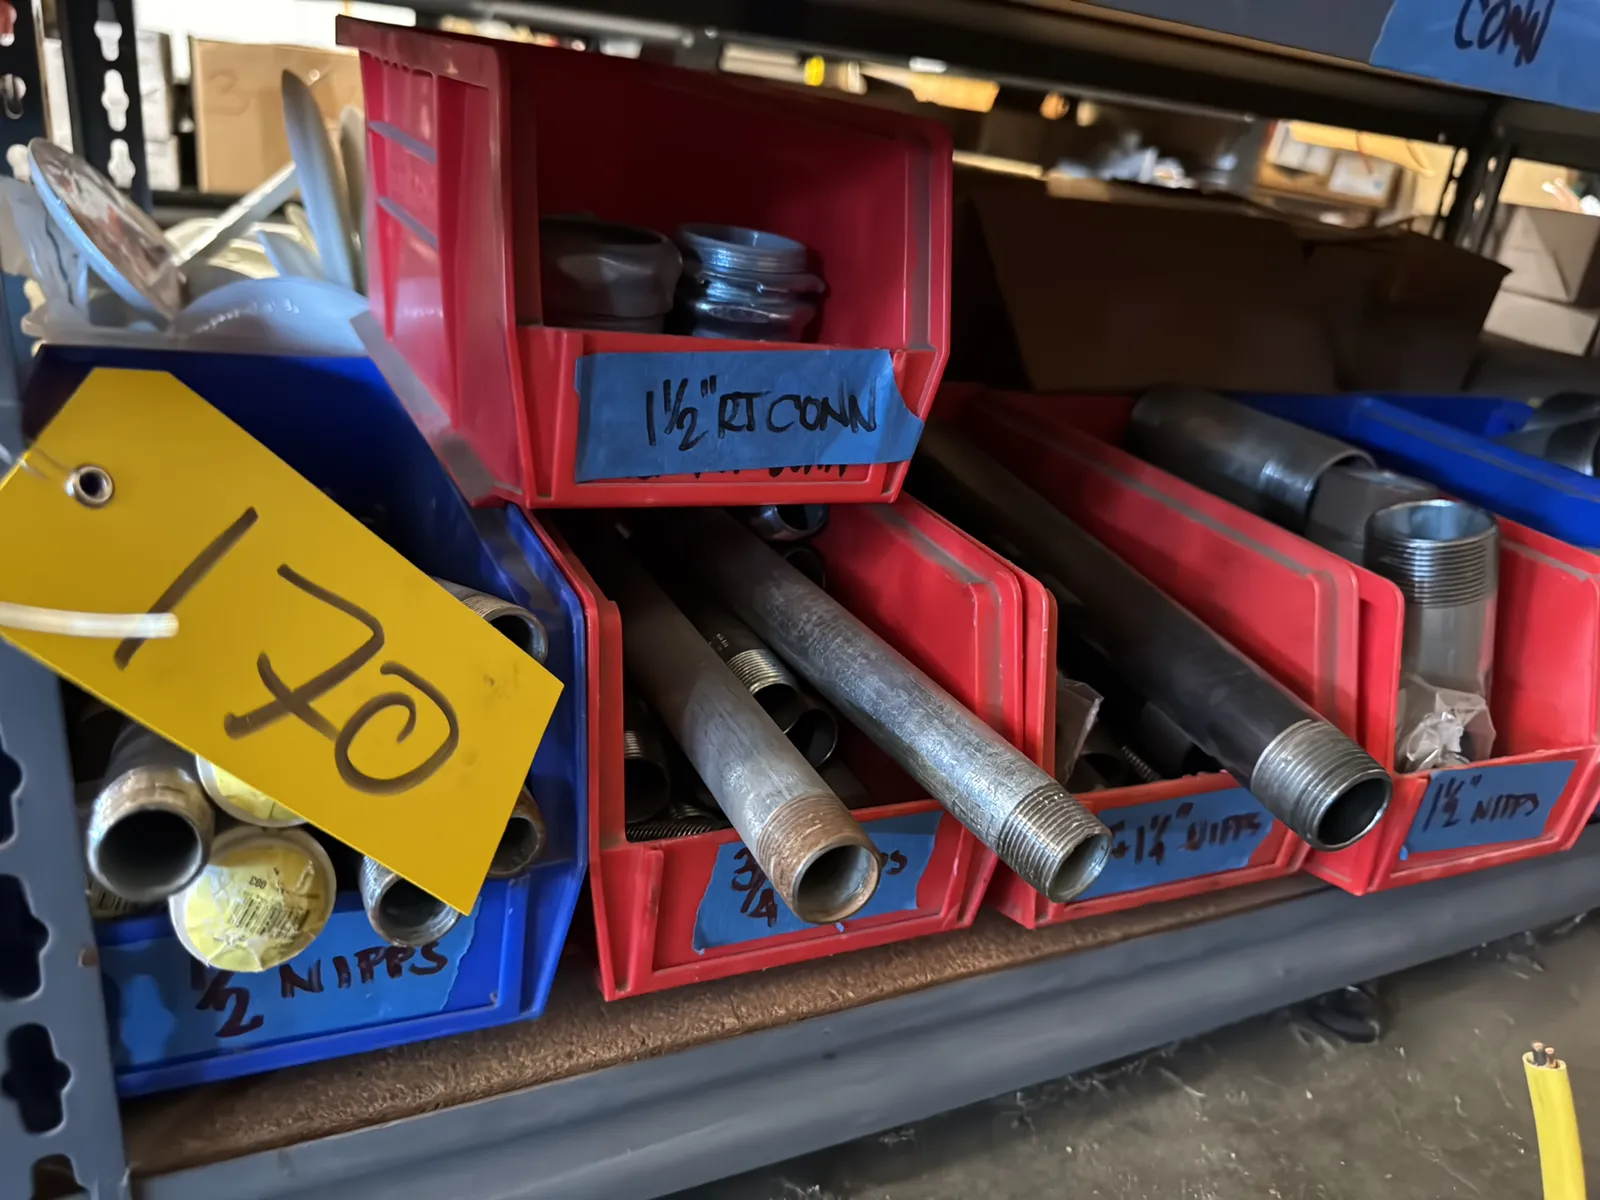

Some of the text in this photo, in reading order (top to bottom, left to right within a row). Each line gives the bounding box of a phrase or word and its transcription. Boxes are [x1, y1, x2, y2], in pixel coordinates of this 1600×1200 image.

[766, 377, 877, 433] CONN
[114, 506, 460, 796] 170
[279, 941, 448, 998] NIPPS
